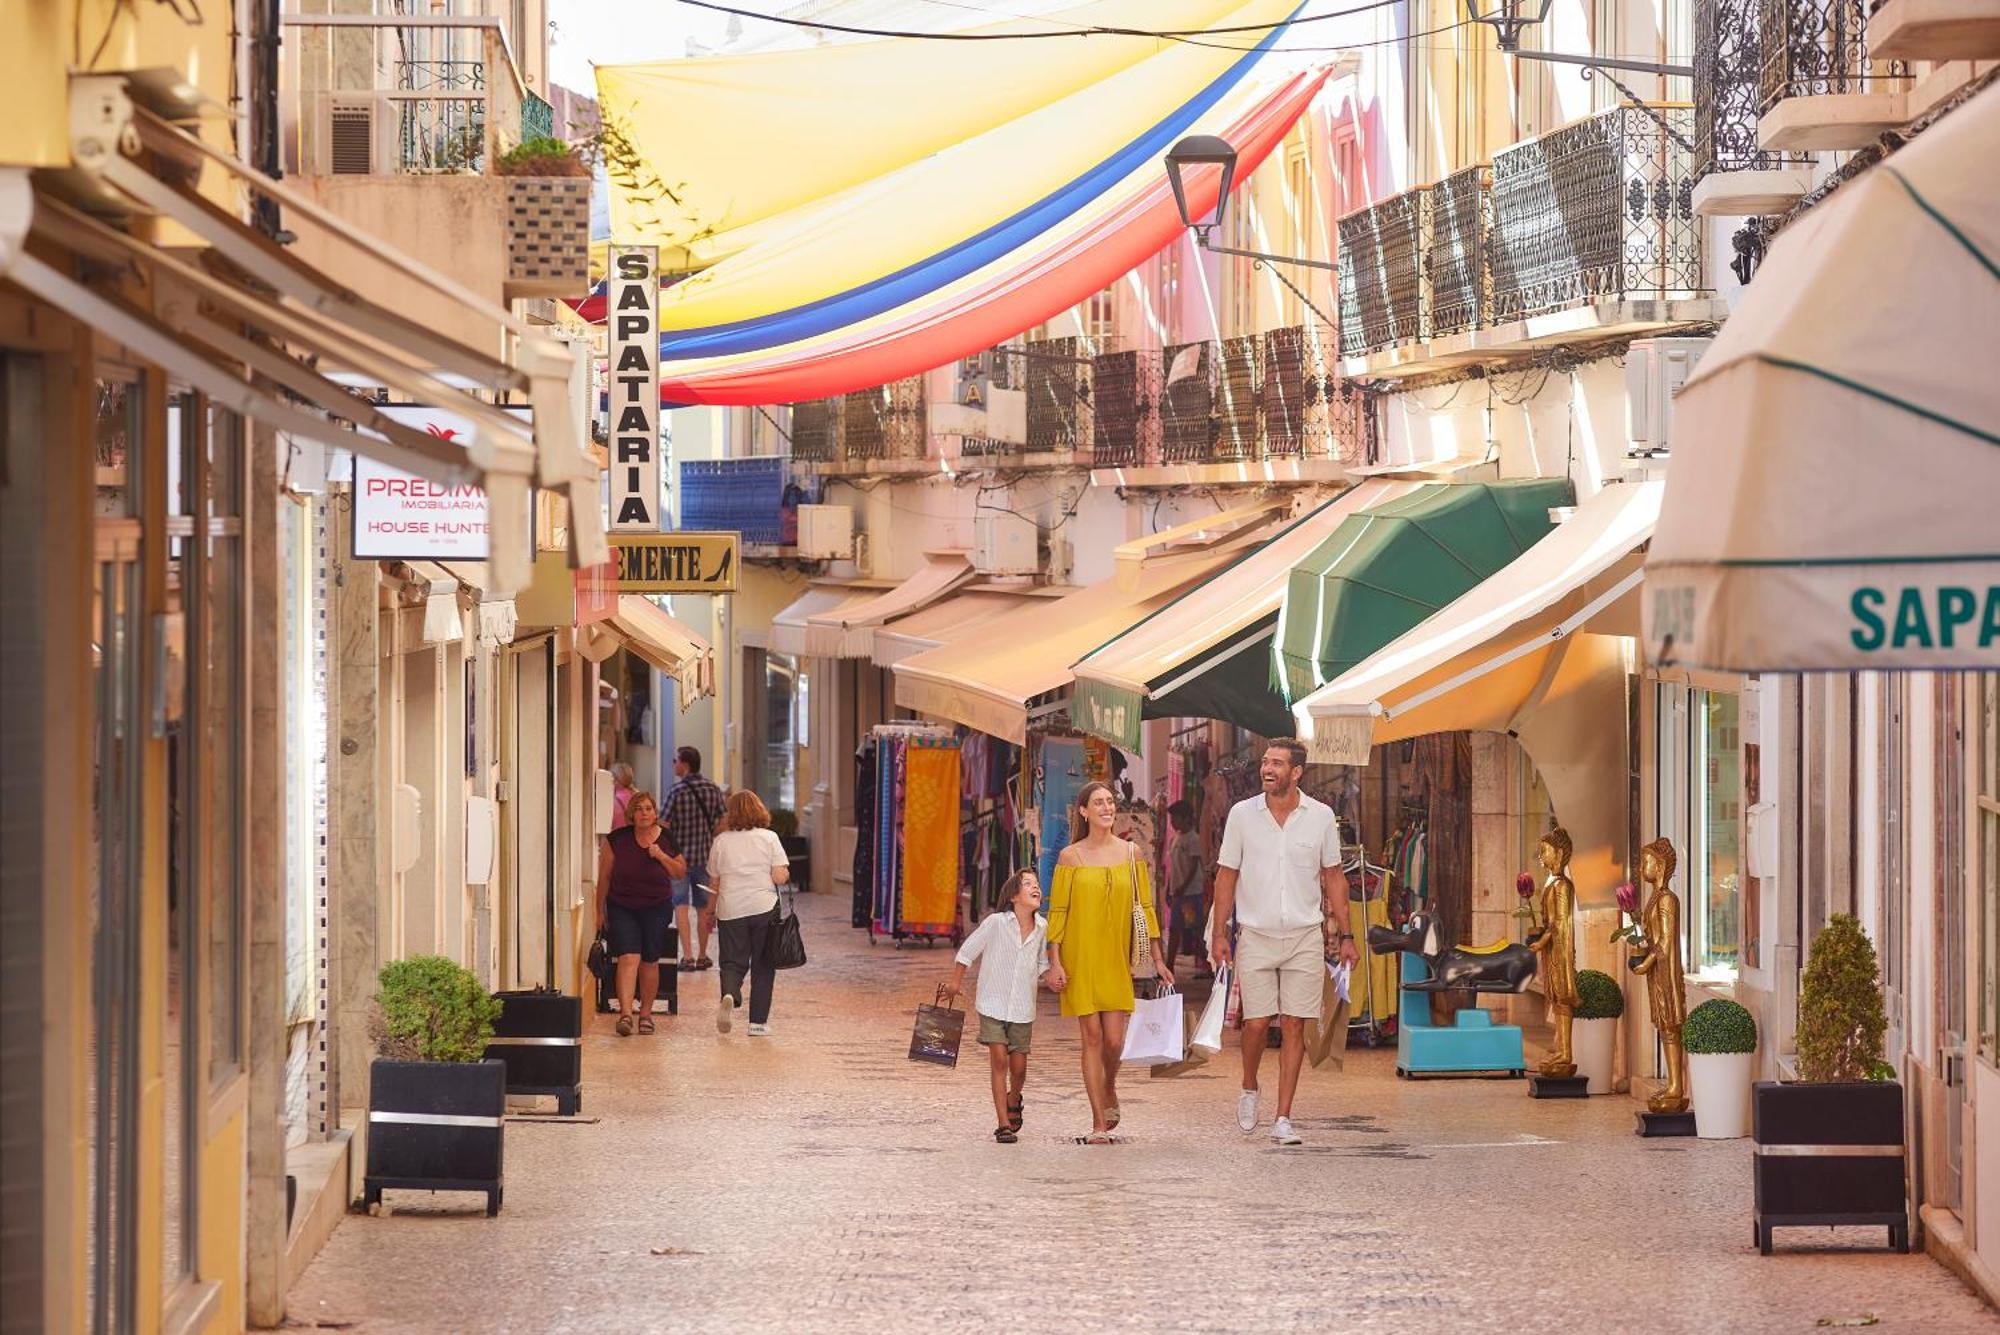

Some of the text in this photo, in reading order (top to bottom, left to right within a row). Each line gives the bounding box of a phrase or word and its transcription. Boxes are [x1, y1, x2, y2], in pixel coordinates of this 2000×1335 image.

[617, 254, 650, 523] SAPATARIA
[401, 500, 486, 510] IMOBILIARIA
[367, 521, 430, 533] HOUSE
